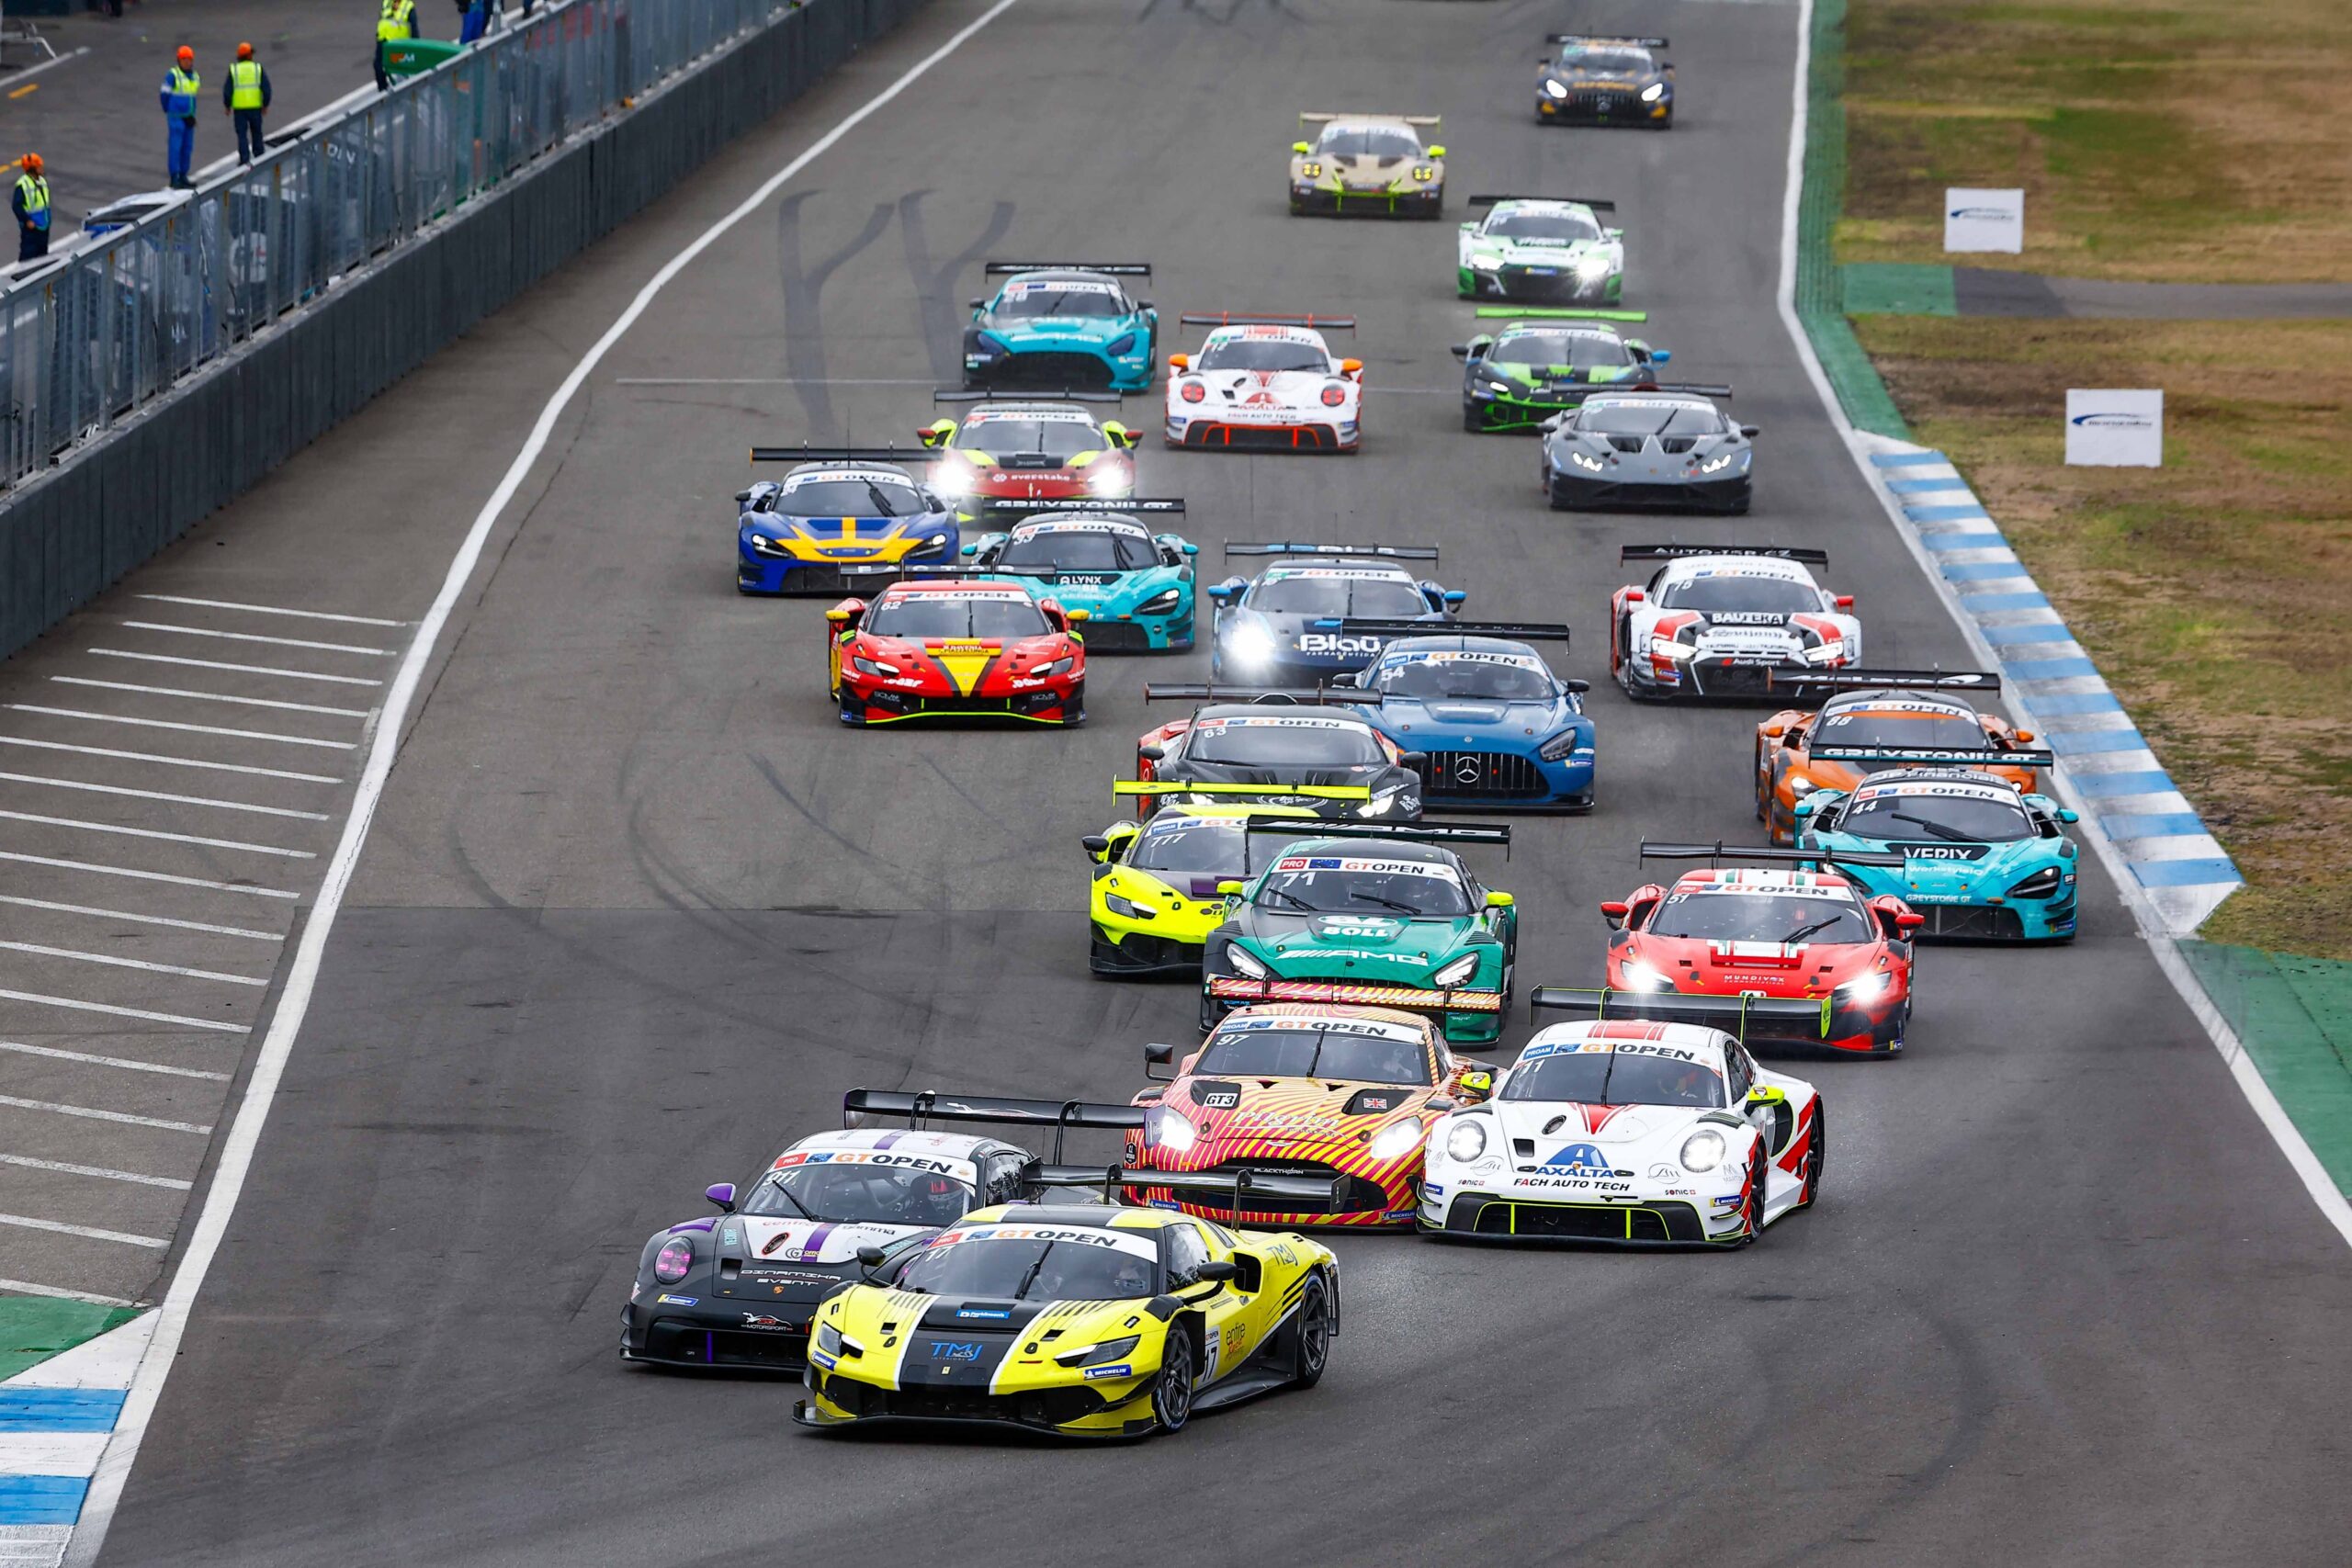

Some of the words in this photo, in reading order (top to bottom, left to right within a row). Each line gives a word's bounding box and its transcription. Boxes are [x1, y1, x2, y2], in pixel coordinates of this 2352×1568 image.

[1071, 576, 1102, 584] LYNX
[881, 601, 901, 611] 62
[1381, 666, 1406, 682] 54
[1826, 716, 1854, 727] 88
[1204, 727, 1227, 739] 63
[1852, 800, 1879, 816] 44
[1150, 833, 1188, 848] 777
[1282, 860, 1306, 869] PRO
[1345, 862, 1425, 874] GTOPEN
[1283, 873, 1317, 887] 71
[1724, 885, 1829, 897] GTOPEN
[1667, 894, 1690, 905] 51
[1322, 927, 1389, 938] BOLL
[1276, 1020, 1388, 1036] GTOPEN
[1216, 1034, 1250, 1045] 97
[1526, 1046, 1553, 1057] PROAM
[1583, 1043, 1695, 1061] GTOPEN
[1522, 1059, 1546, 1074] 11
[1206, 1094, 1235, 1106] GT3
[1231, 1111, 1340, 1126] Pilgrim
[782, 1156, 799, 1166] PRO
[834, 1153, 954, 1174] GTOPEN
[1535, 1166, 1615, 1179] AXALTA
[1552, 1179, 1589, 1189] AUTO
[1594, 1181, 1631, 1191] TECH
[996, 1230, 1118, 1247] GTOPEN
[924, 1245, 956, 1263] 17
[757, 1278, 820, 1286] EVENT
[930, 1341, 984, 1361] TMJ
[1093, 1367, 1127, 1376] MICHELIN
